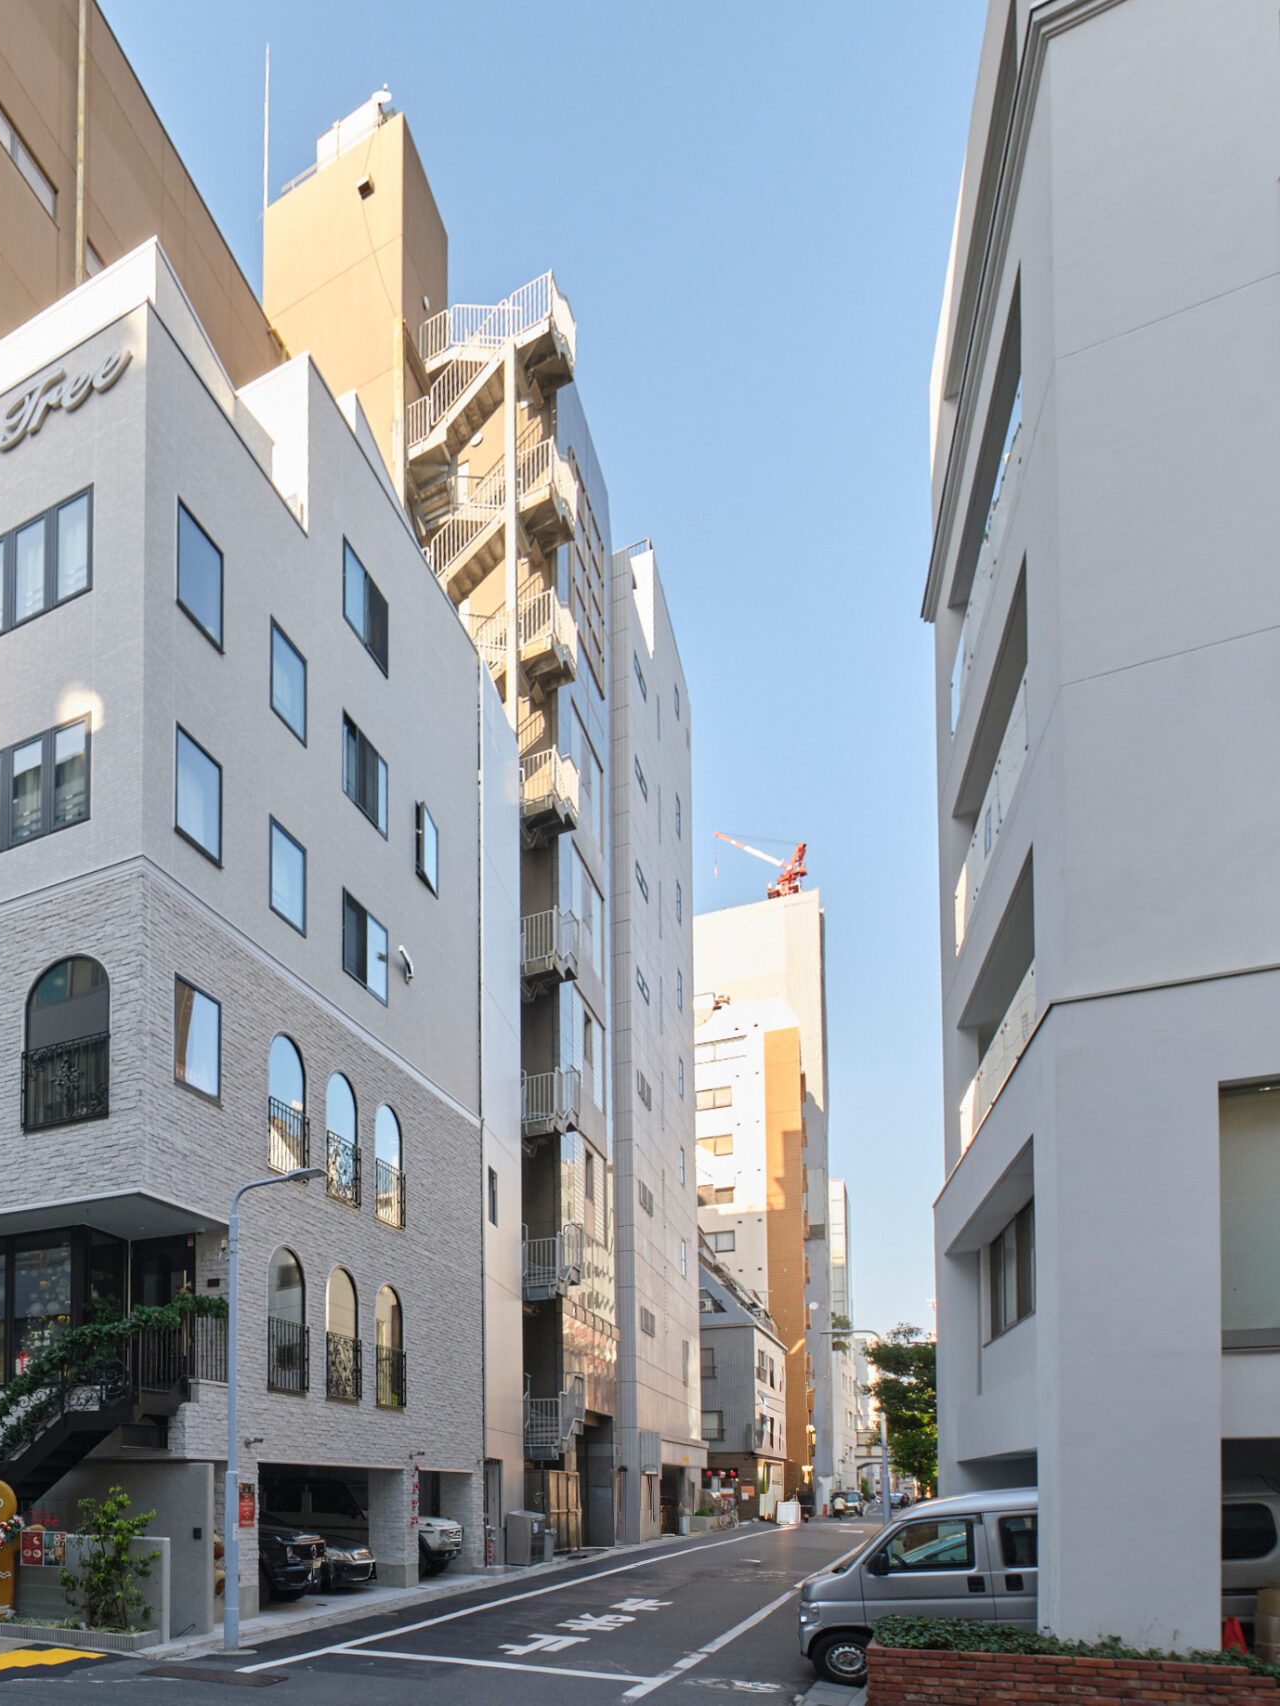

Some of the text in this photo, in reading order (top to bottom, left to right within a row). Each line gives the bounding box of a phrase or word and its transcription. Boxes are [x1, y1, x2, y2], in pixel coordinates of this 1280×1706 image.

[28, 1510, 61, 1527] Tree
[497, 1597, 674, 1655] 止まれ
